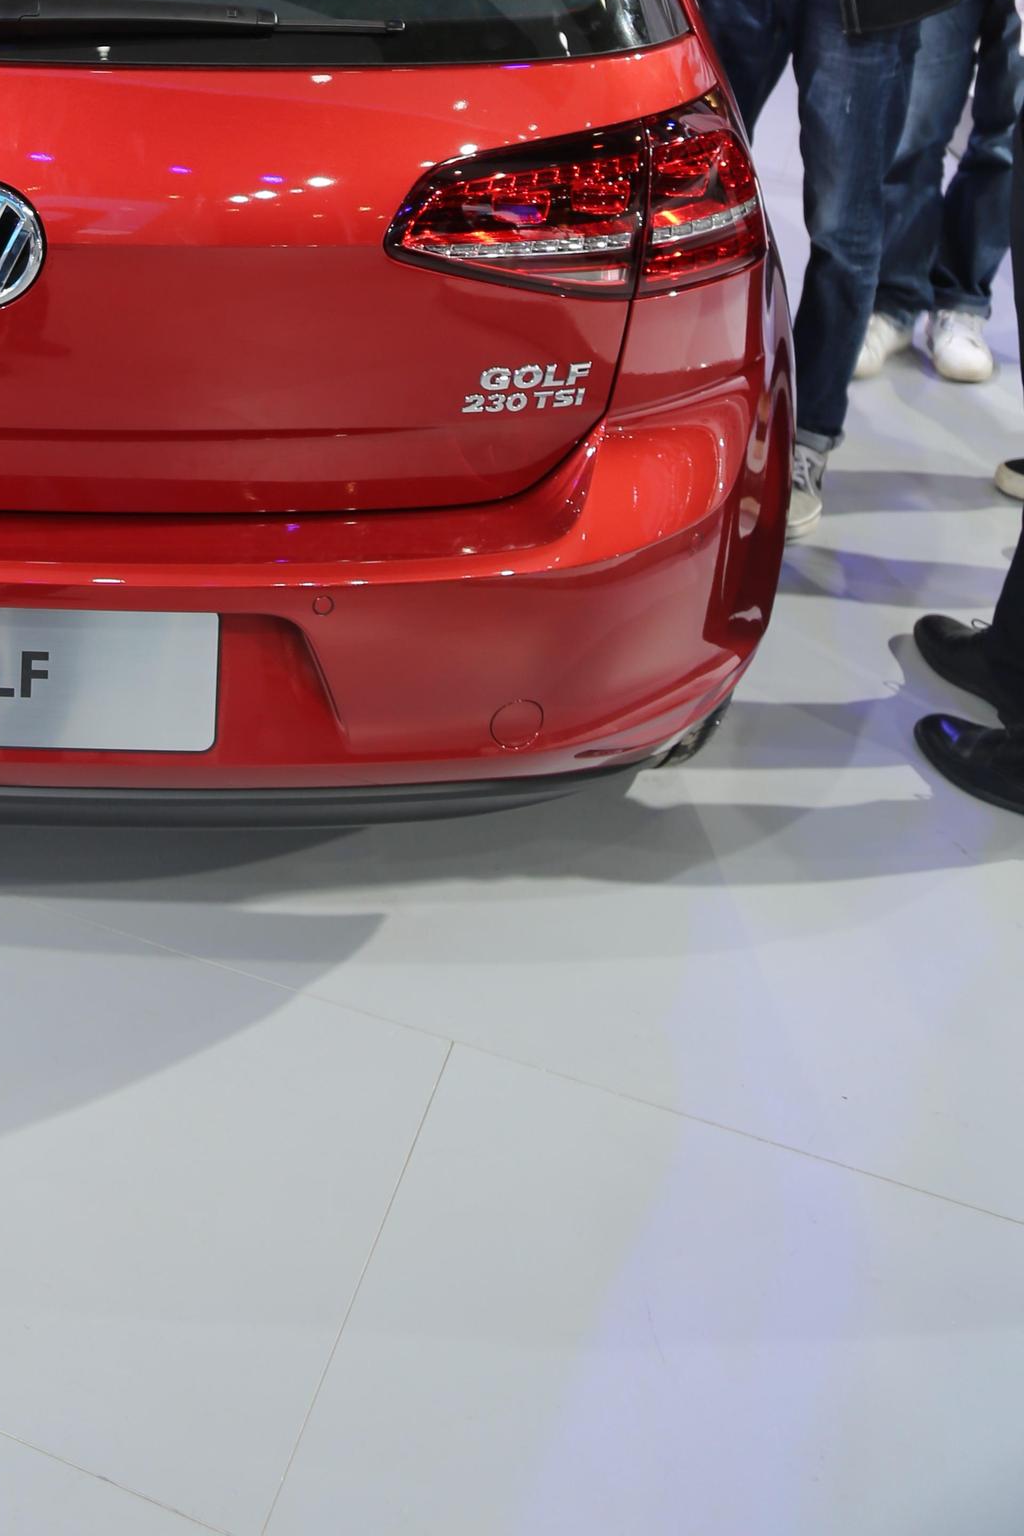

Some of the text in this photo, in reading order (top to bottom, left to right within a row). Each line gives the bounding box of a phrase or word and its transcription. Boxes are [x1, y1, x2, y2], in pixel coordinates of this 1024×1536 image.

[480, 361, 592, 390] GOLF
[462, 387, 585, 413] 230 TSI
